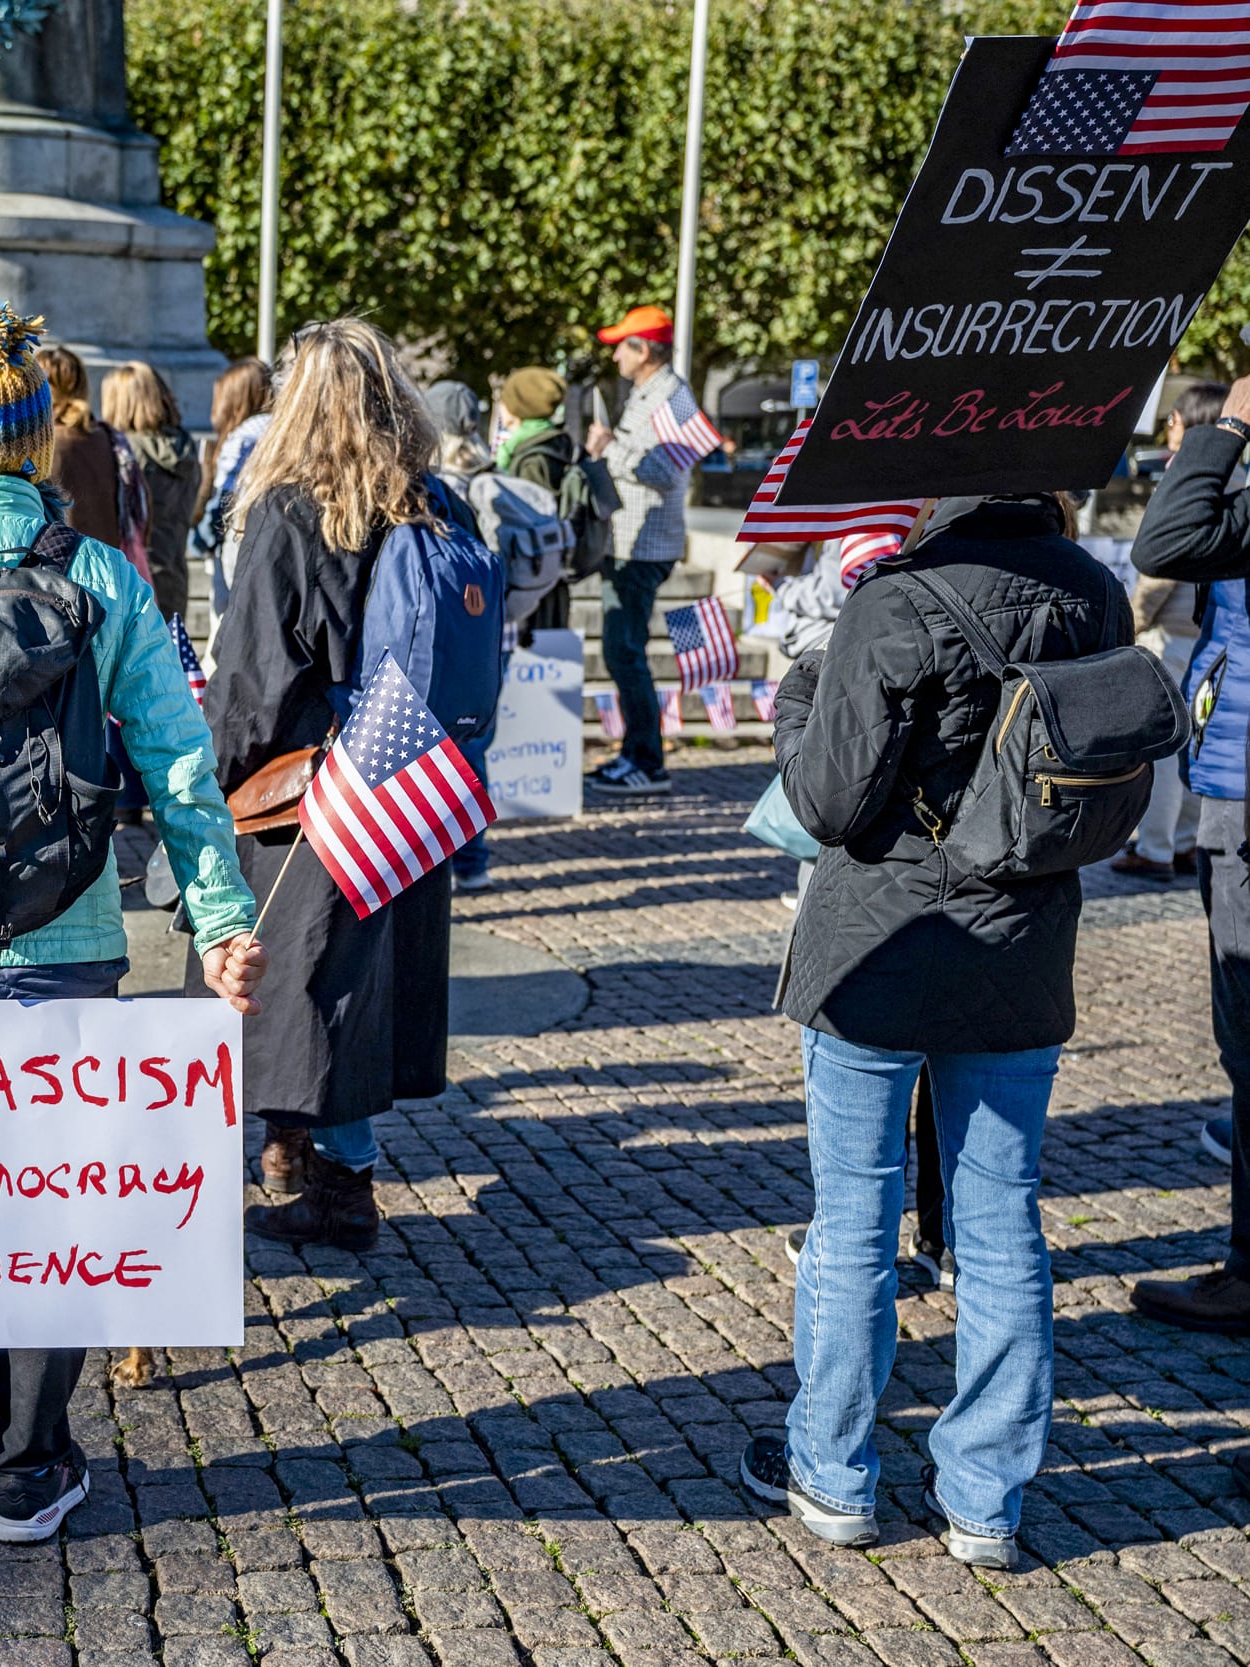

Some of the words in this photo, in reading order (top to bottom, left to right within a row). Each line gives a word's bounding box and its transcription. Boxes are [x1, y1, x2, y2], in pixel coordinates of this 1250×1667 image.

[940, 161, 1234, 225] DISSENT
[850, 293, 1204, 365] INSURRECTION
[830, 390, 928, 441] Let's
[930, 388, 999, 437] Be
[998, 381, 1134, 431] Loud
[488, 739, 567, 769] overning
